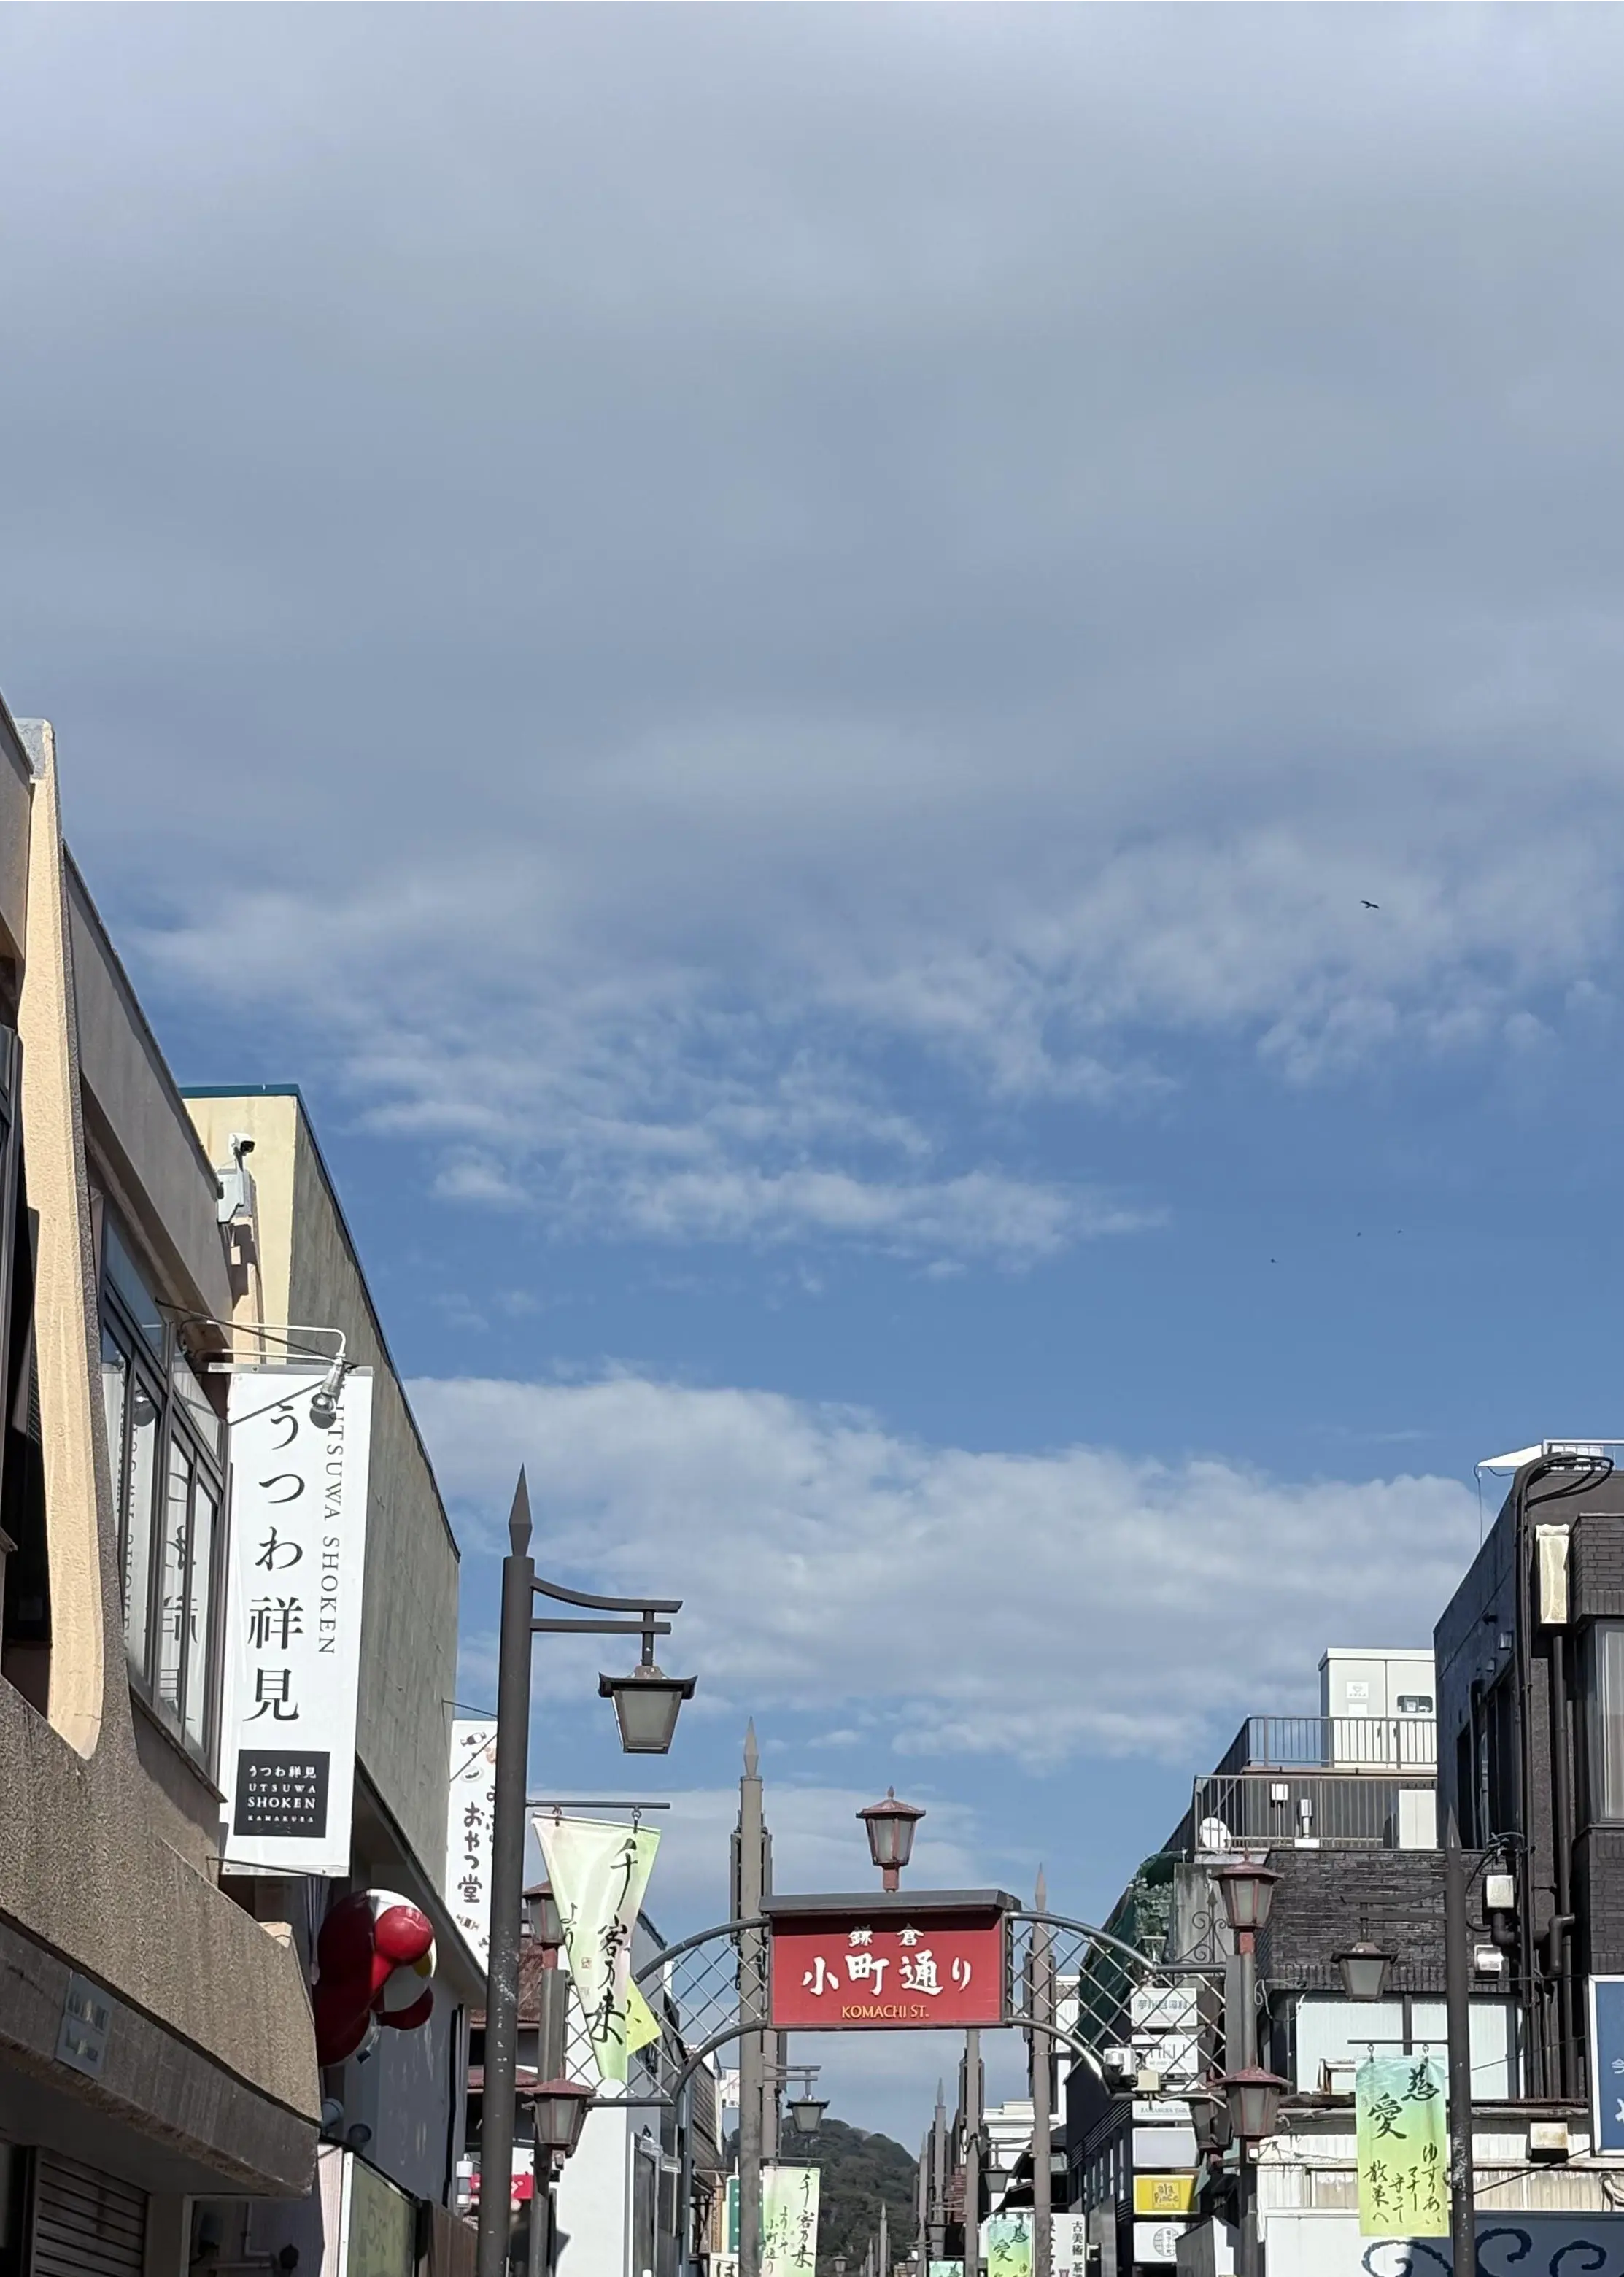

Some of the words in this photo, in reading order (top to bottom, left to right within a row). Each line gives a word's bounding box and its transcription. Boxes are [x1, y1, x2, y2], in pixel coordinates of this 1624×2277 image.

[244, 1405, 306, 1723] うつわ祥見
[318, 1536, 341, 1655] SHOKEN
[248, 1765, 317, 1779] うつわ祥見
[248, 1782, 316, 1793] UTSUWA
[247, 1796, 316, 1809] SHOKEN
[247, 1814, 314, 1822] KAMAKURA
[457, 1801, 485, 1903] おやつ堂
[584, 1838, 638, 2045] 千客万来
[847, 1924, 924, 1947] 鎌倉
[801, 1949, 973, 1998] 小町通り
[841, 2004, 907, 2019] KOMACHI
[910, 2004, 930, 2018] ST.
